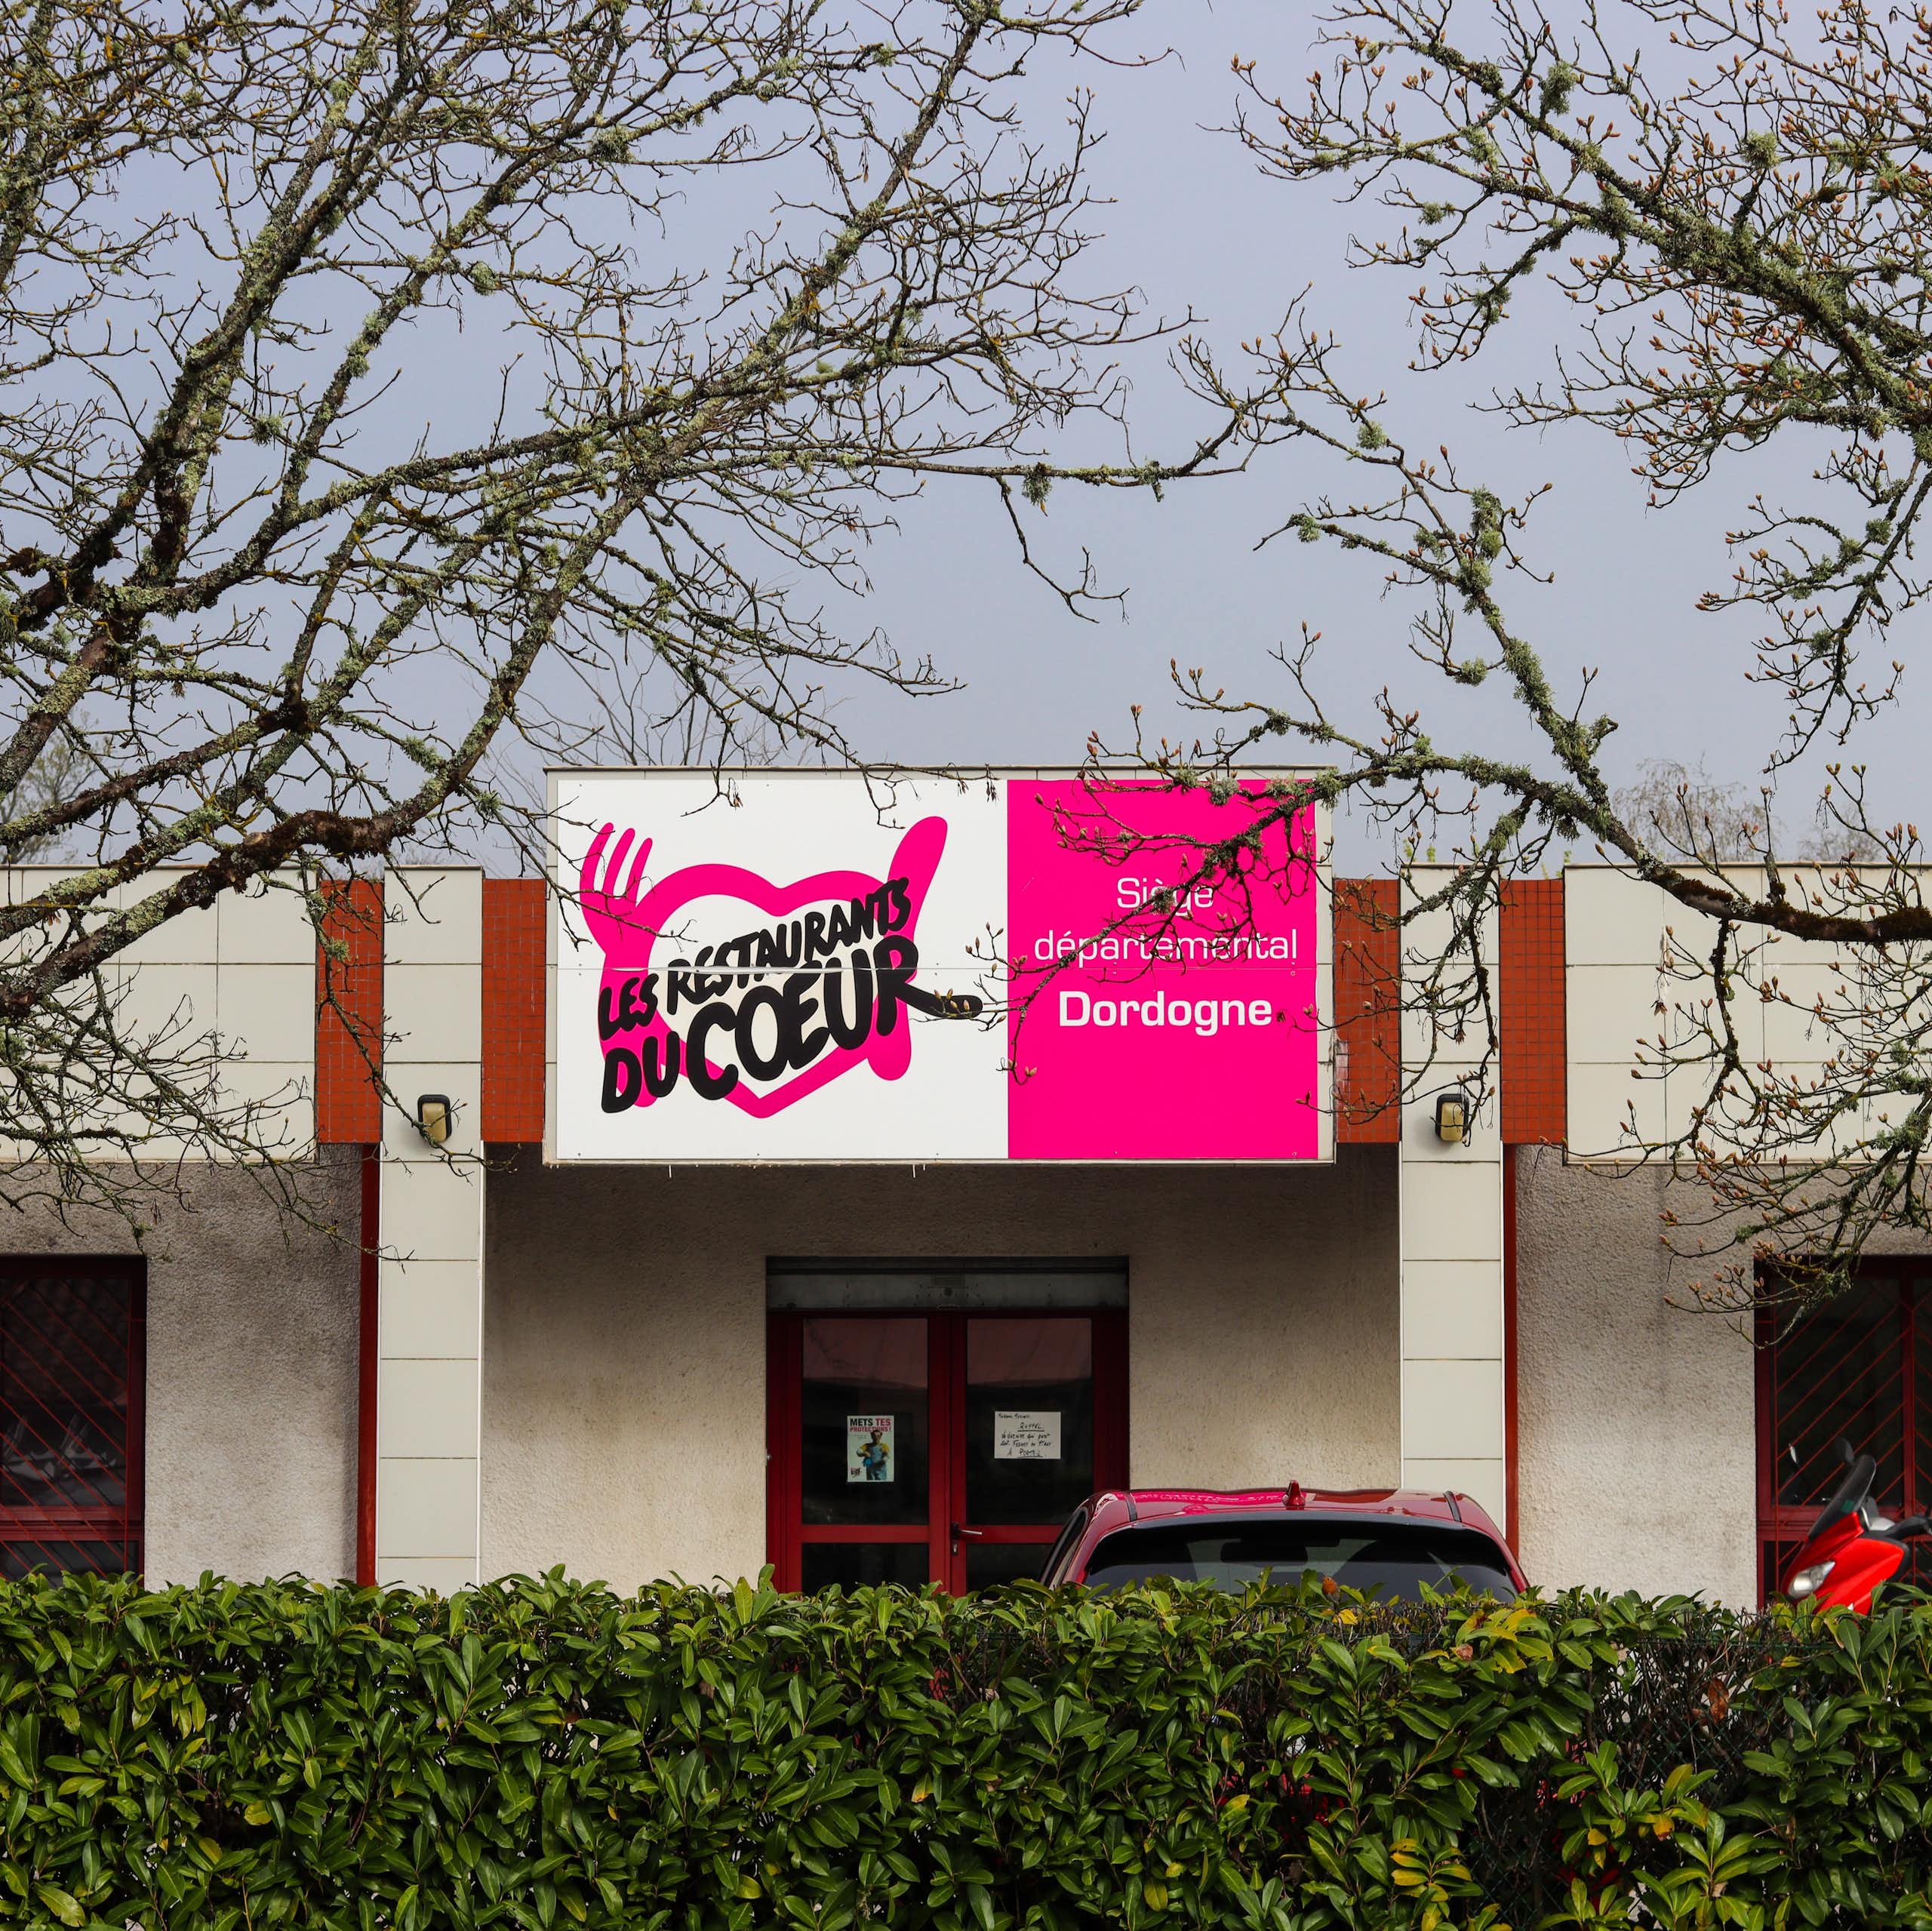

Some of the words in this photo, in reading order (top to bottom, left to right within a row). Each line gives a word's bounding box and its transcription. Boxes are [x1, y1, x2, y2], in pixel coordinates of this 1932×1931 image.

[598, 973, 658, 1041] LES
[666, 876, 912, 1016] RESTAURANTS
[1033, 928, 1297, 968] départemental
[1058, 990, 1272, 1037] Dordogne
[601, 1031, 681, 1114] DU
[850, 1418, 873, 1426] METS
[875, 1418, 891, 1426] TES
